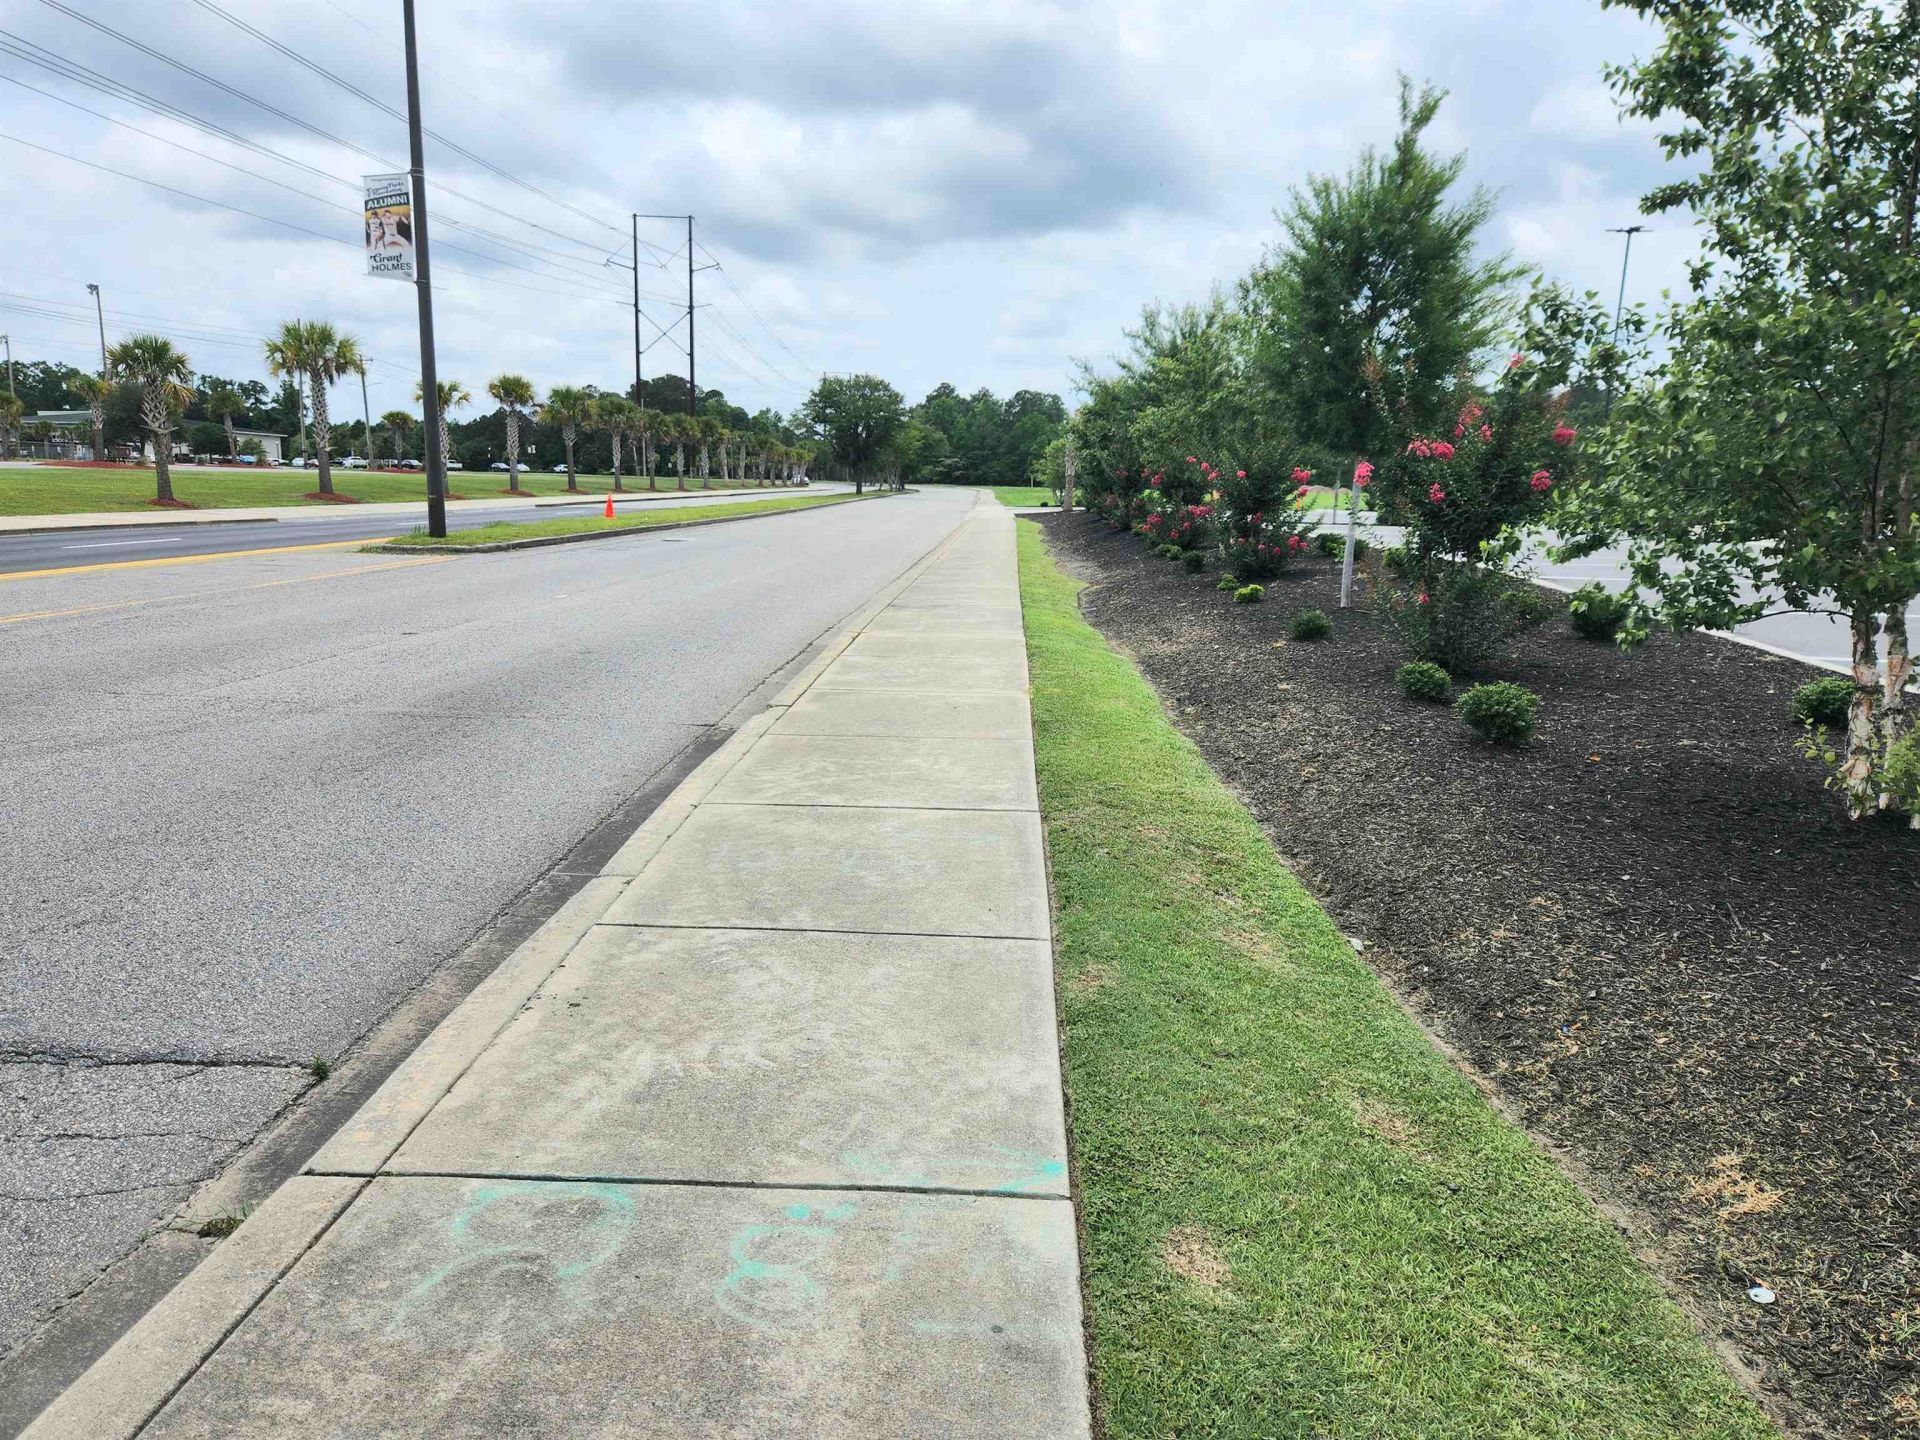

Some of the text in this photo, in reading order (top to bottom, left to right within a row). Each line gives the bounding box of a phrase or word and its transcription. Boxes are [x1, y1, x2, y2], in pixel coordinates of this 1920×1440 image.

[367, 194, 407, 209] ALUMNI
[370, 252, 402, 263] Grant
[372, 263, 412, 271] HOLMES
